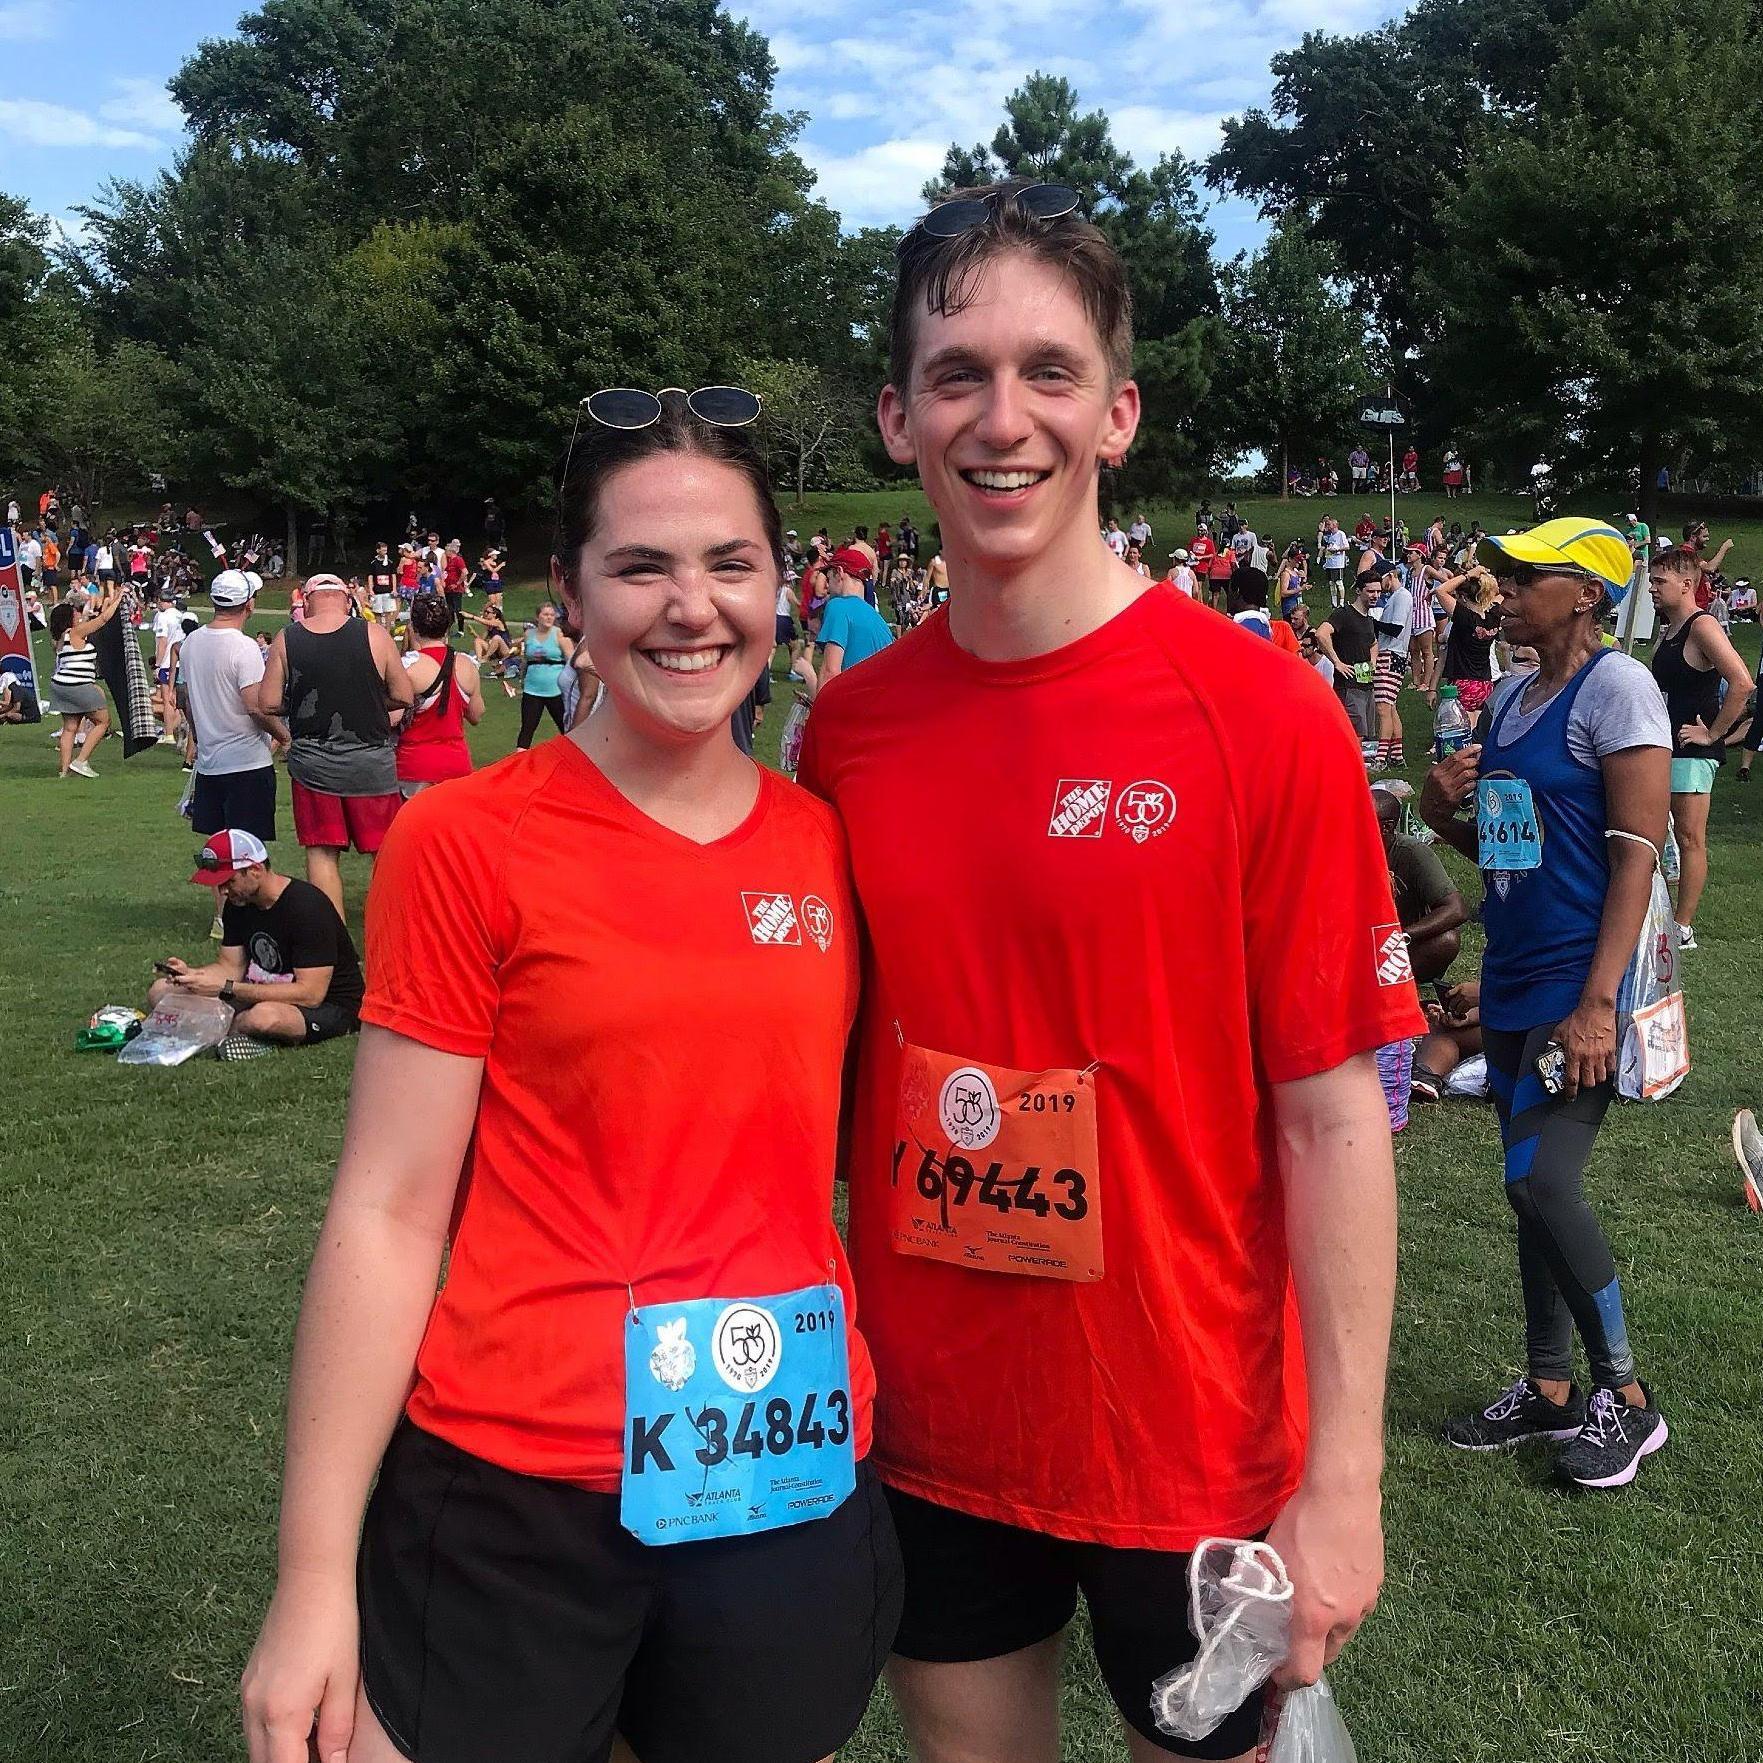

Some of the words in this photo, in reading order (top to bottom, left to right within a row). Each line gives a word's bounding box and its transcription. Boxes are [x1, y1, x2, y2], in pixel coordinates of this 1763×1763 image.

[1050, 780, 1109, 836] HOME
[1060, 785, 1084, 808] THE
[752, 895, 793, 942] HOME
[1379, 929, 1403, 956] THE
[1019, 1093, 1076, 1113] 2019
[917, 1149, 1088, 1221] 69443
[1008, 1254, 1068, 1268] POWERADE
[795, 1310, 835, 1334] 2019
[630, 1413, 676, 1475] K
[694, 1389, 849, 1467] 34843
[705, 1488, 741, 1501] ATLANTA
[787, 1494, 835, 1510] POWERADE
